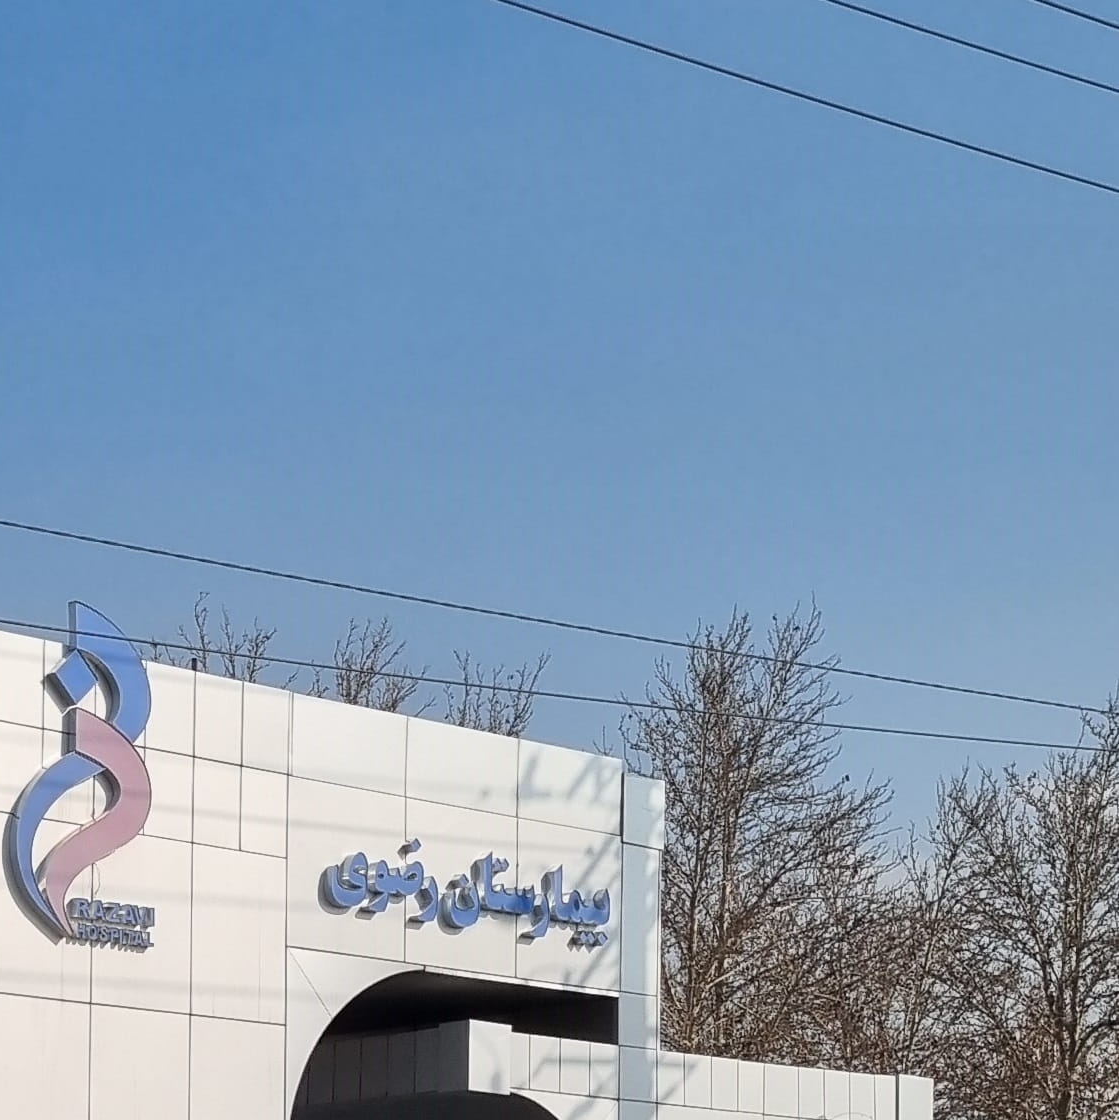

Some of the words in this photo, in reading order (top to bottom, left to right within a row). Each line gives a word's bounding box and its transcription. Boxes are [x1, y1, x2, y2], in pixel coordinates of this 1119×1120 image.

[322, 838, 438, 925] رضوی
[438, 852, 611, 947] بیمارستان
[70, 898, 155, 925] RAZAVI
[73, 922, 154, 949] HOSPITAL
